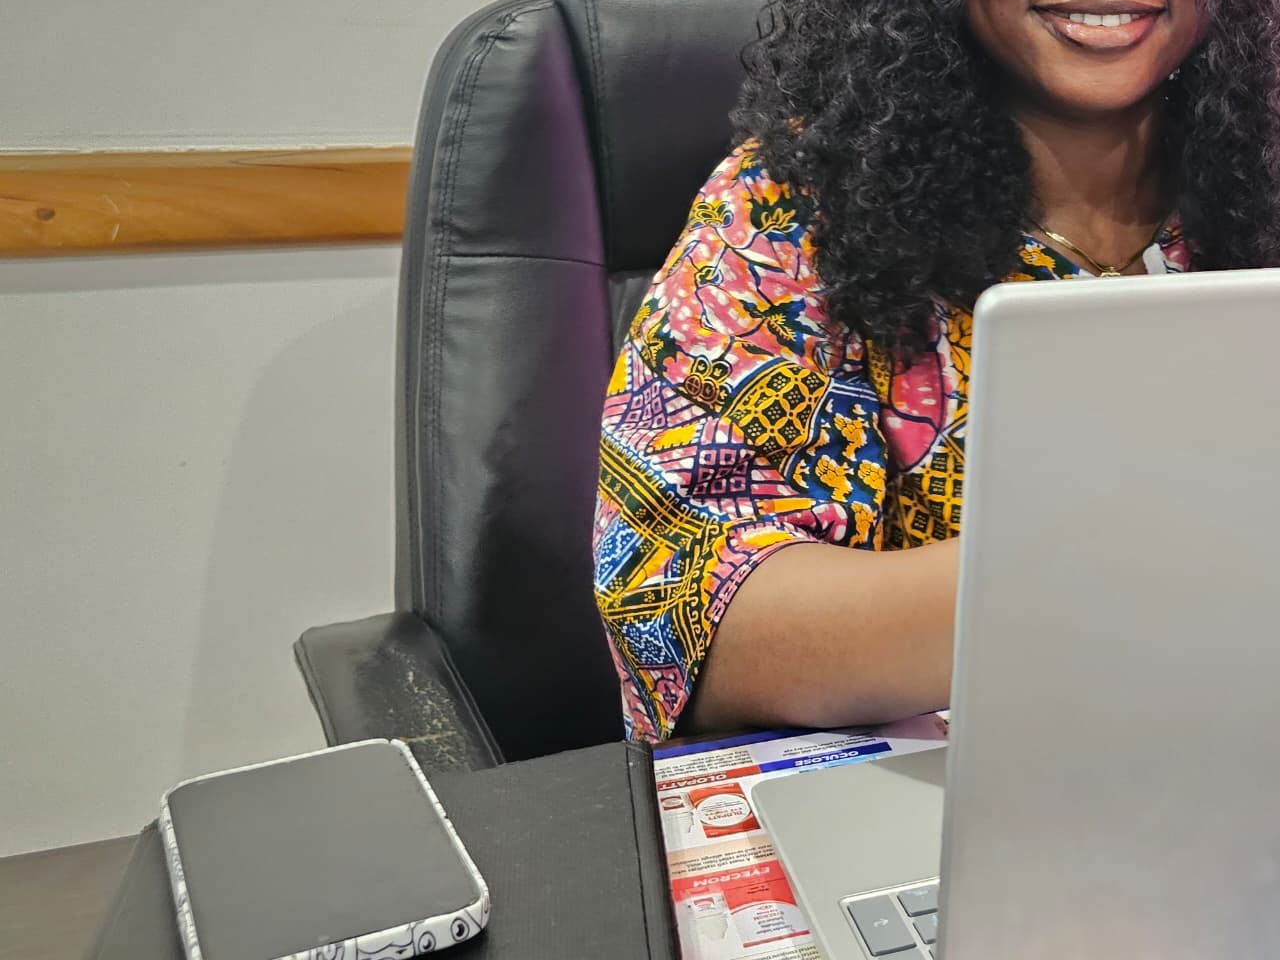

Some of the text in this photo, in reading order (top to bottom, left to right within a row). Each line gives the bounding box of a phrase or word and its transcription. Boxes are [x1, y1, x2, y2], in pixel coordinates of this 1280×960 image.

[794, 750, 859, 767] OCULOSE
[658, 773, 727, 790] OLOPATT
[692, 866, 771, 887] EYECROM
